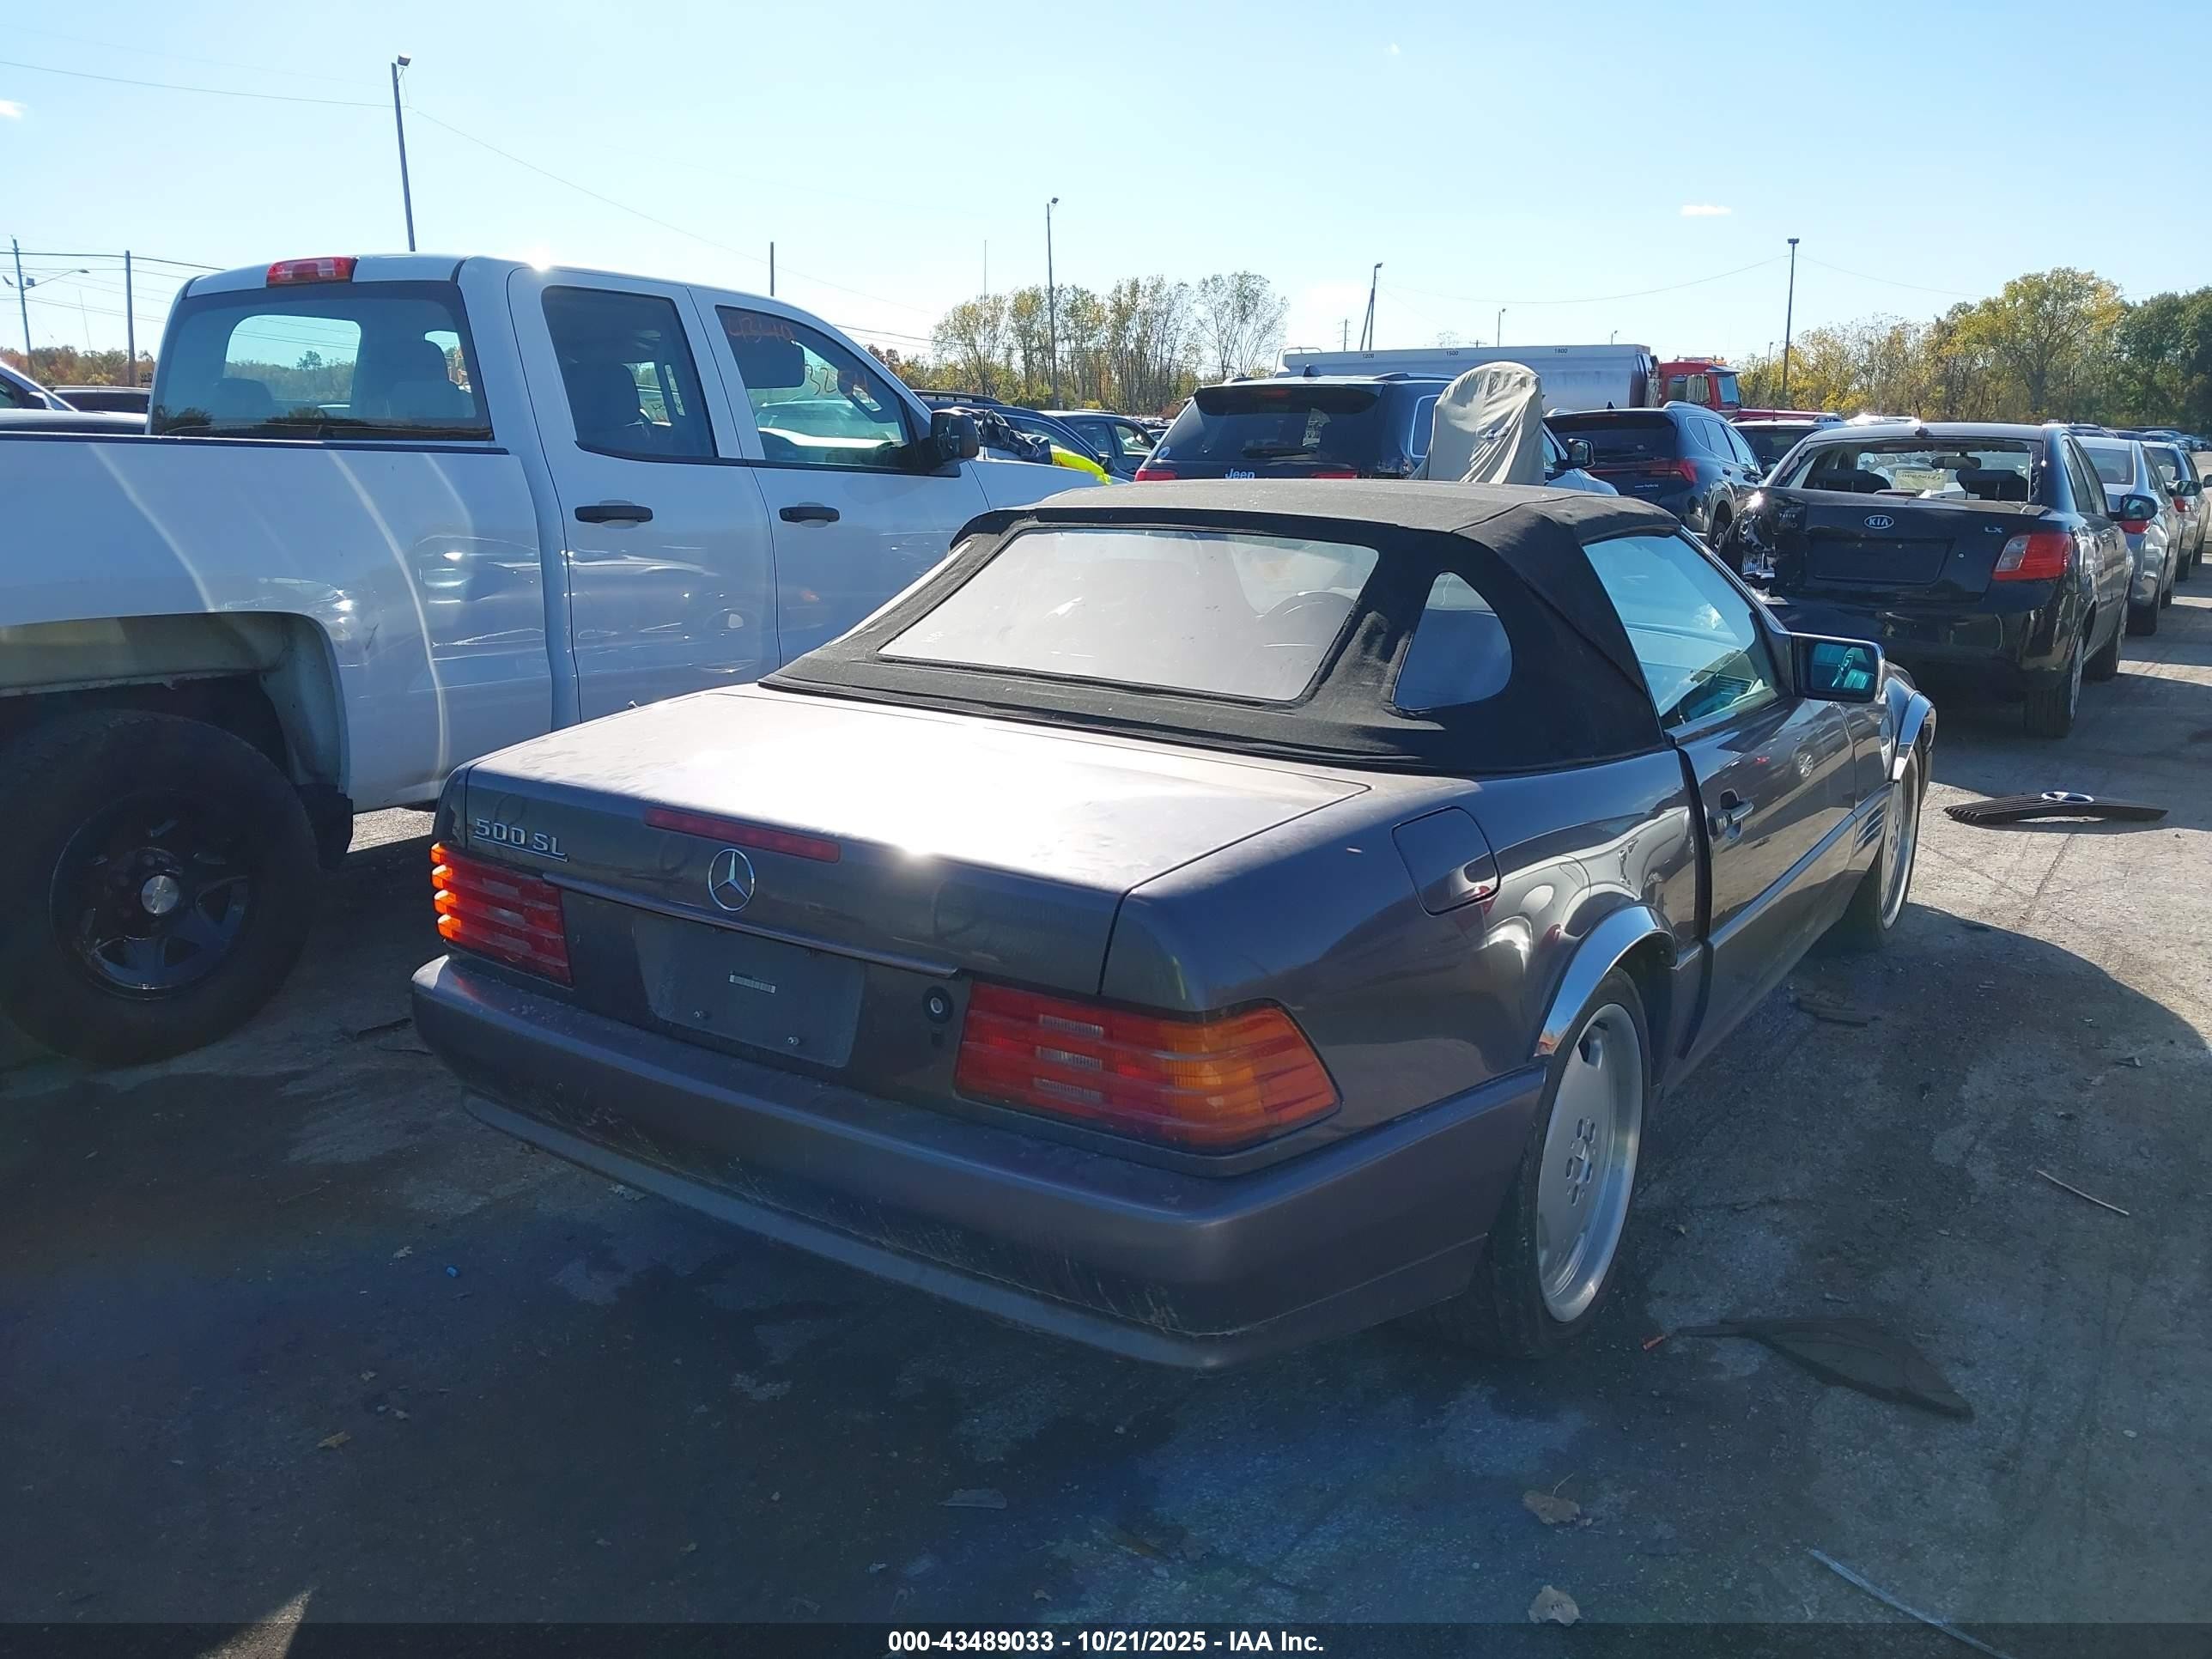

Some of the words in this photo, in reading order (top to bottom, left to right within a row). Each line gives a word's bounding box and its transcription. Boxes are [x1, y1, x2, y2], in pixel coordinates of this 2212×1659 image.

[1869, 518, 1889, 526] KIA
[474, 817, 526, 845] 500
[532, 832, 567, 856] SL
